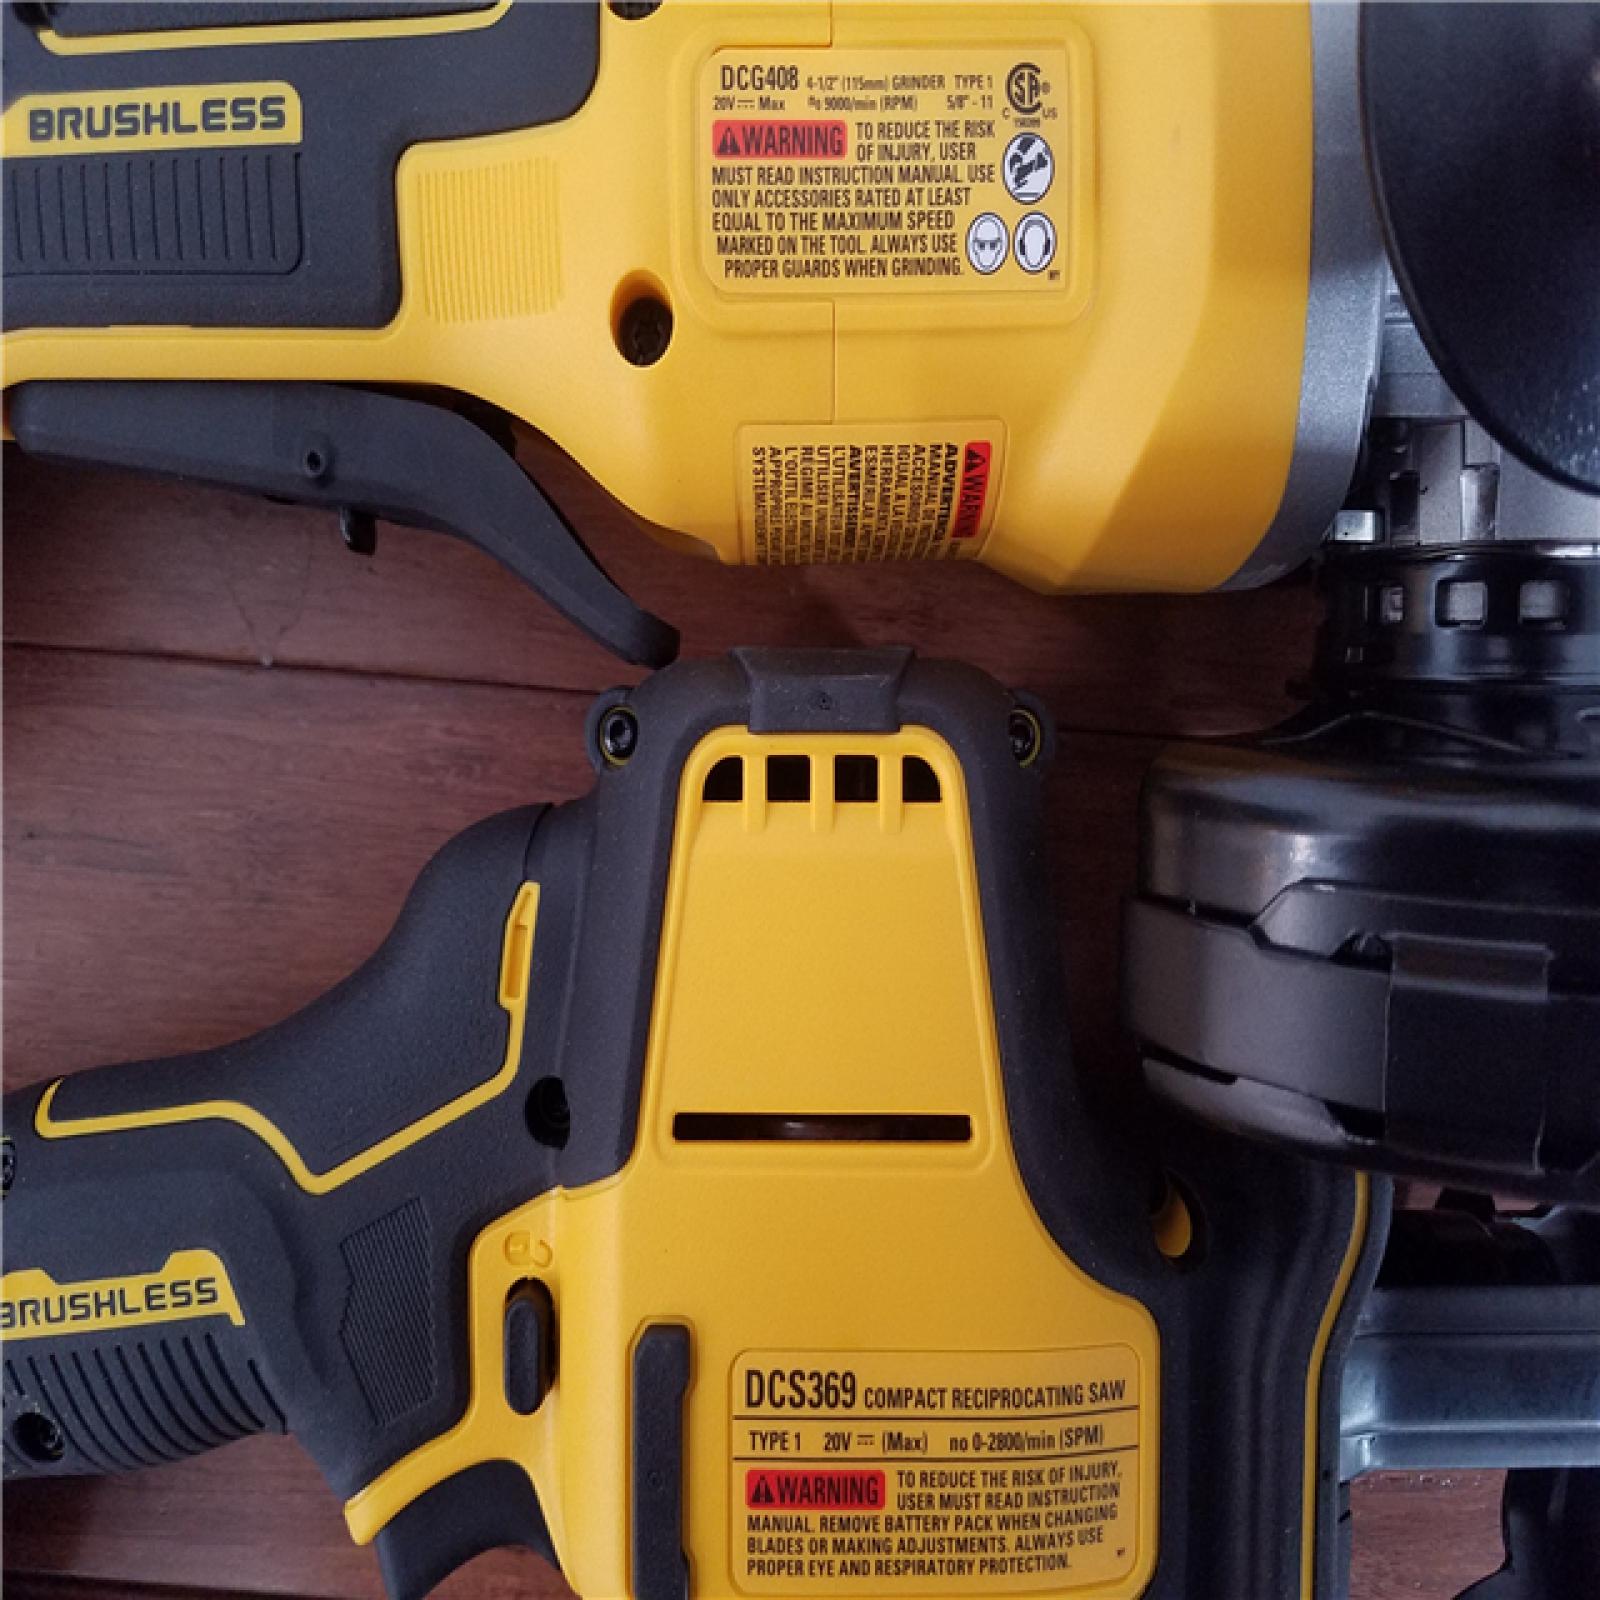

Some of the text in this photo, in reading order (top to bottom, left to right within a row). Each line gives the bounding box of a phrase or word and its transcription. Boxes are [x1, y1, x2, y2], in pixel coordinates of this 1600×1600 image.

[721, 64, 798, 90] DCG408
[892, 74, 945, 91] GRINDER
[954, 74, 983, 90] TYPE
[986, 74, 993, 90] 1
[713, 95, 735, 111] 20V
[758, 95, 785, 111] Max
[880, 94, 917, 112] (RPM)
[981, 94, 993, 110] 11
[28, 95, 286, 141] BRUSHLESS
[855, 120, 874, 140] TO
[877, 120, 931, 140] REDUCE
[934, 119, 960, 139] THE
[964, 119, 995, 138] RISK
[742, 125, 843, 155] WARNING
[856, 142, 874, 161] OF
[939, 141, 975, 161] USER
[712, 166, 752, 185] MUST
[757, 166, 795, 185] READ
[799, 165, 893, 185] INSTRUCTION
[967, 164, 995, 183] USE
[712, 186, 972, 208] ONLY ACCESSORIES RATED AT LEAST
[712, 210, 955, 232] EQUAL TO THE MAXIMUM SPEED
[717, 235, 773, 255] MARKED
[777, 235, 798, 255] ON
[801, 235, 826, 255] THE
[871, 234, 928, 254] ALWAYS
[932, 234, 957, 254] USE
[724, 257, 964, 278] PROPER GUARDS WHEN GRINDING.
[746, 1369, 1126, 1410] DCS369 COMPACT RECIPROCATING SAW
[749, 1431, 788, 1451] TYPE
[794, 1431, 801, 1451] 1
[824, 1431, 852, 1452] 20V
[882, 1430, 928, 1455] (Max)
[972, 1429, 1056, 1453] 0-2800/min
[1060, 1422, 1104, 1450] (SPM)
[897, 1470, 915, 1488] TO
[919, 1470, 975, 1488] REDUCE
[980, 1469, 1008, 1488] THE
[1012, 1469, 1044, 1487] RISK
[1049, 1466, 1066, 1485] OF
[777, 1475, 879, 1505] WARNING
[896, 1482, 1120, 1511] USER MUST READ INSTRUCTION
[747, 1502, 1118, 1534] MANUAL. REMOVE BATTERY PACK WHEN CHANGING
[747, 1536, 803, 1555] BLADES
[809, 1537, 828, 1555] OR
[832, 1537, 893, 1555] MAKING
[1015, 1529, 1075, 1551] ALWAYS
[1077, 1525, 1104, 1545] USE
[747, 1552, 1072, 1577] PROPER EYE AND RESPIRATORY PROTECTION.
